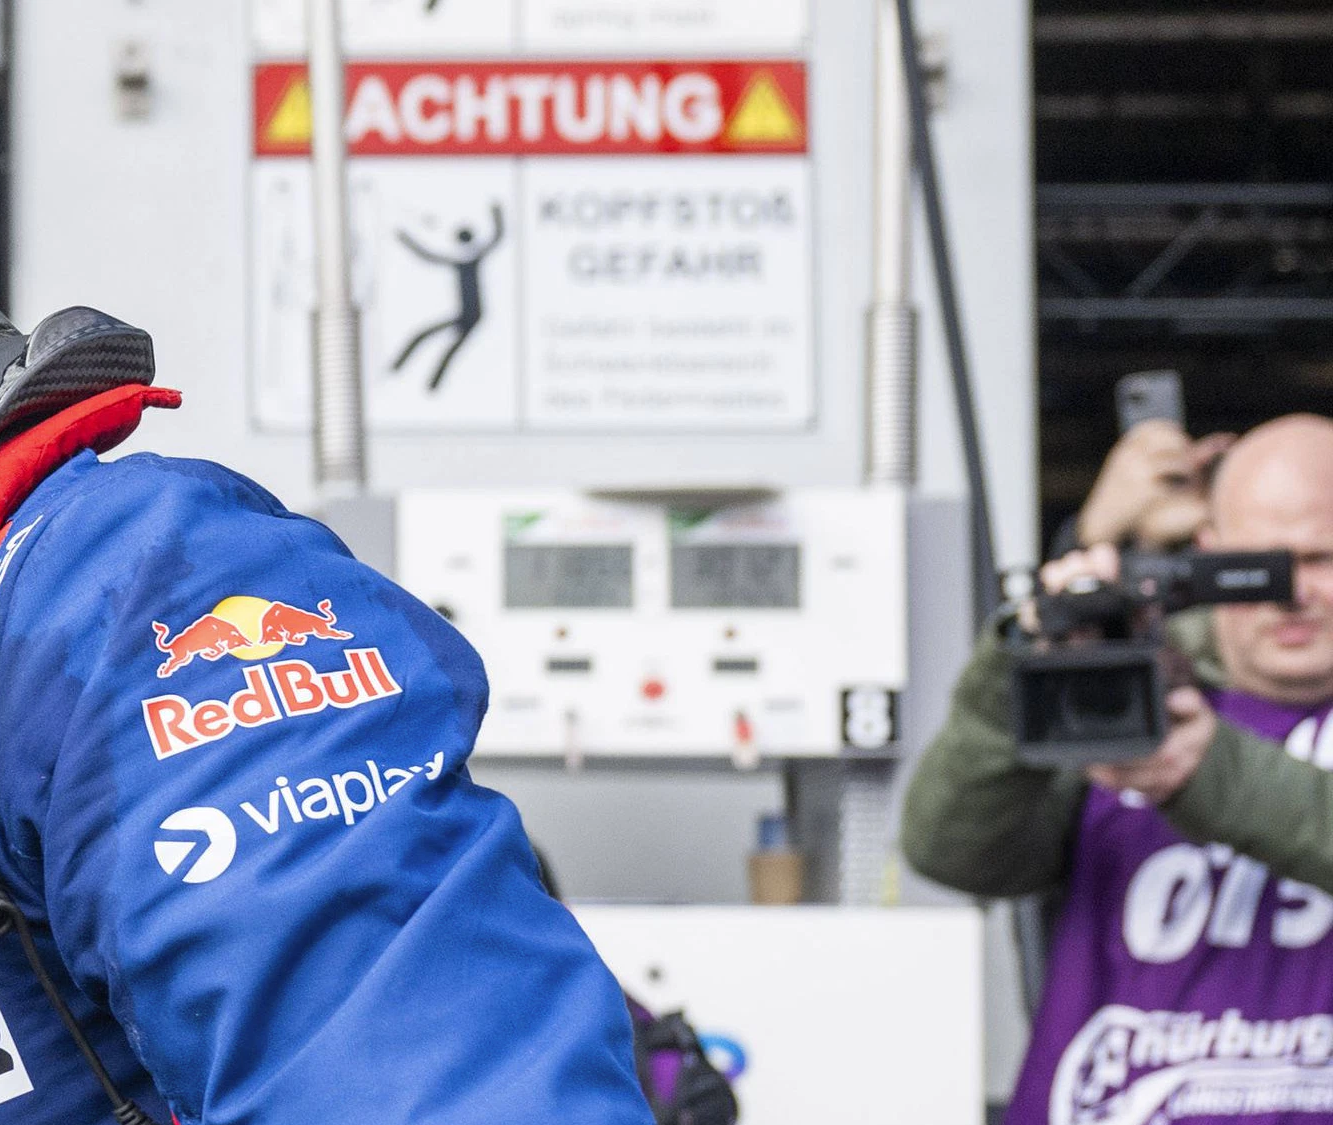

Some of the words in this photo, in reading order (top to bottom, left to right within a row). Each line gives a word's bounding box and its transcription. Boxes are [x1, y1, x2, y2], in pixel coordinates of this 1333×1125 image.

[343, 71, 724, 146] ACHTUNG
[146, 670, 276, 754] Red
[274, 651, 395, 712] Bull
[844, 686, 893, 748] 8
